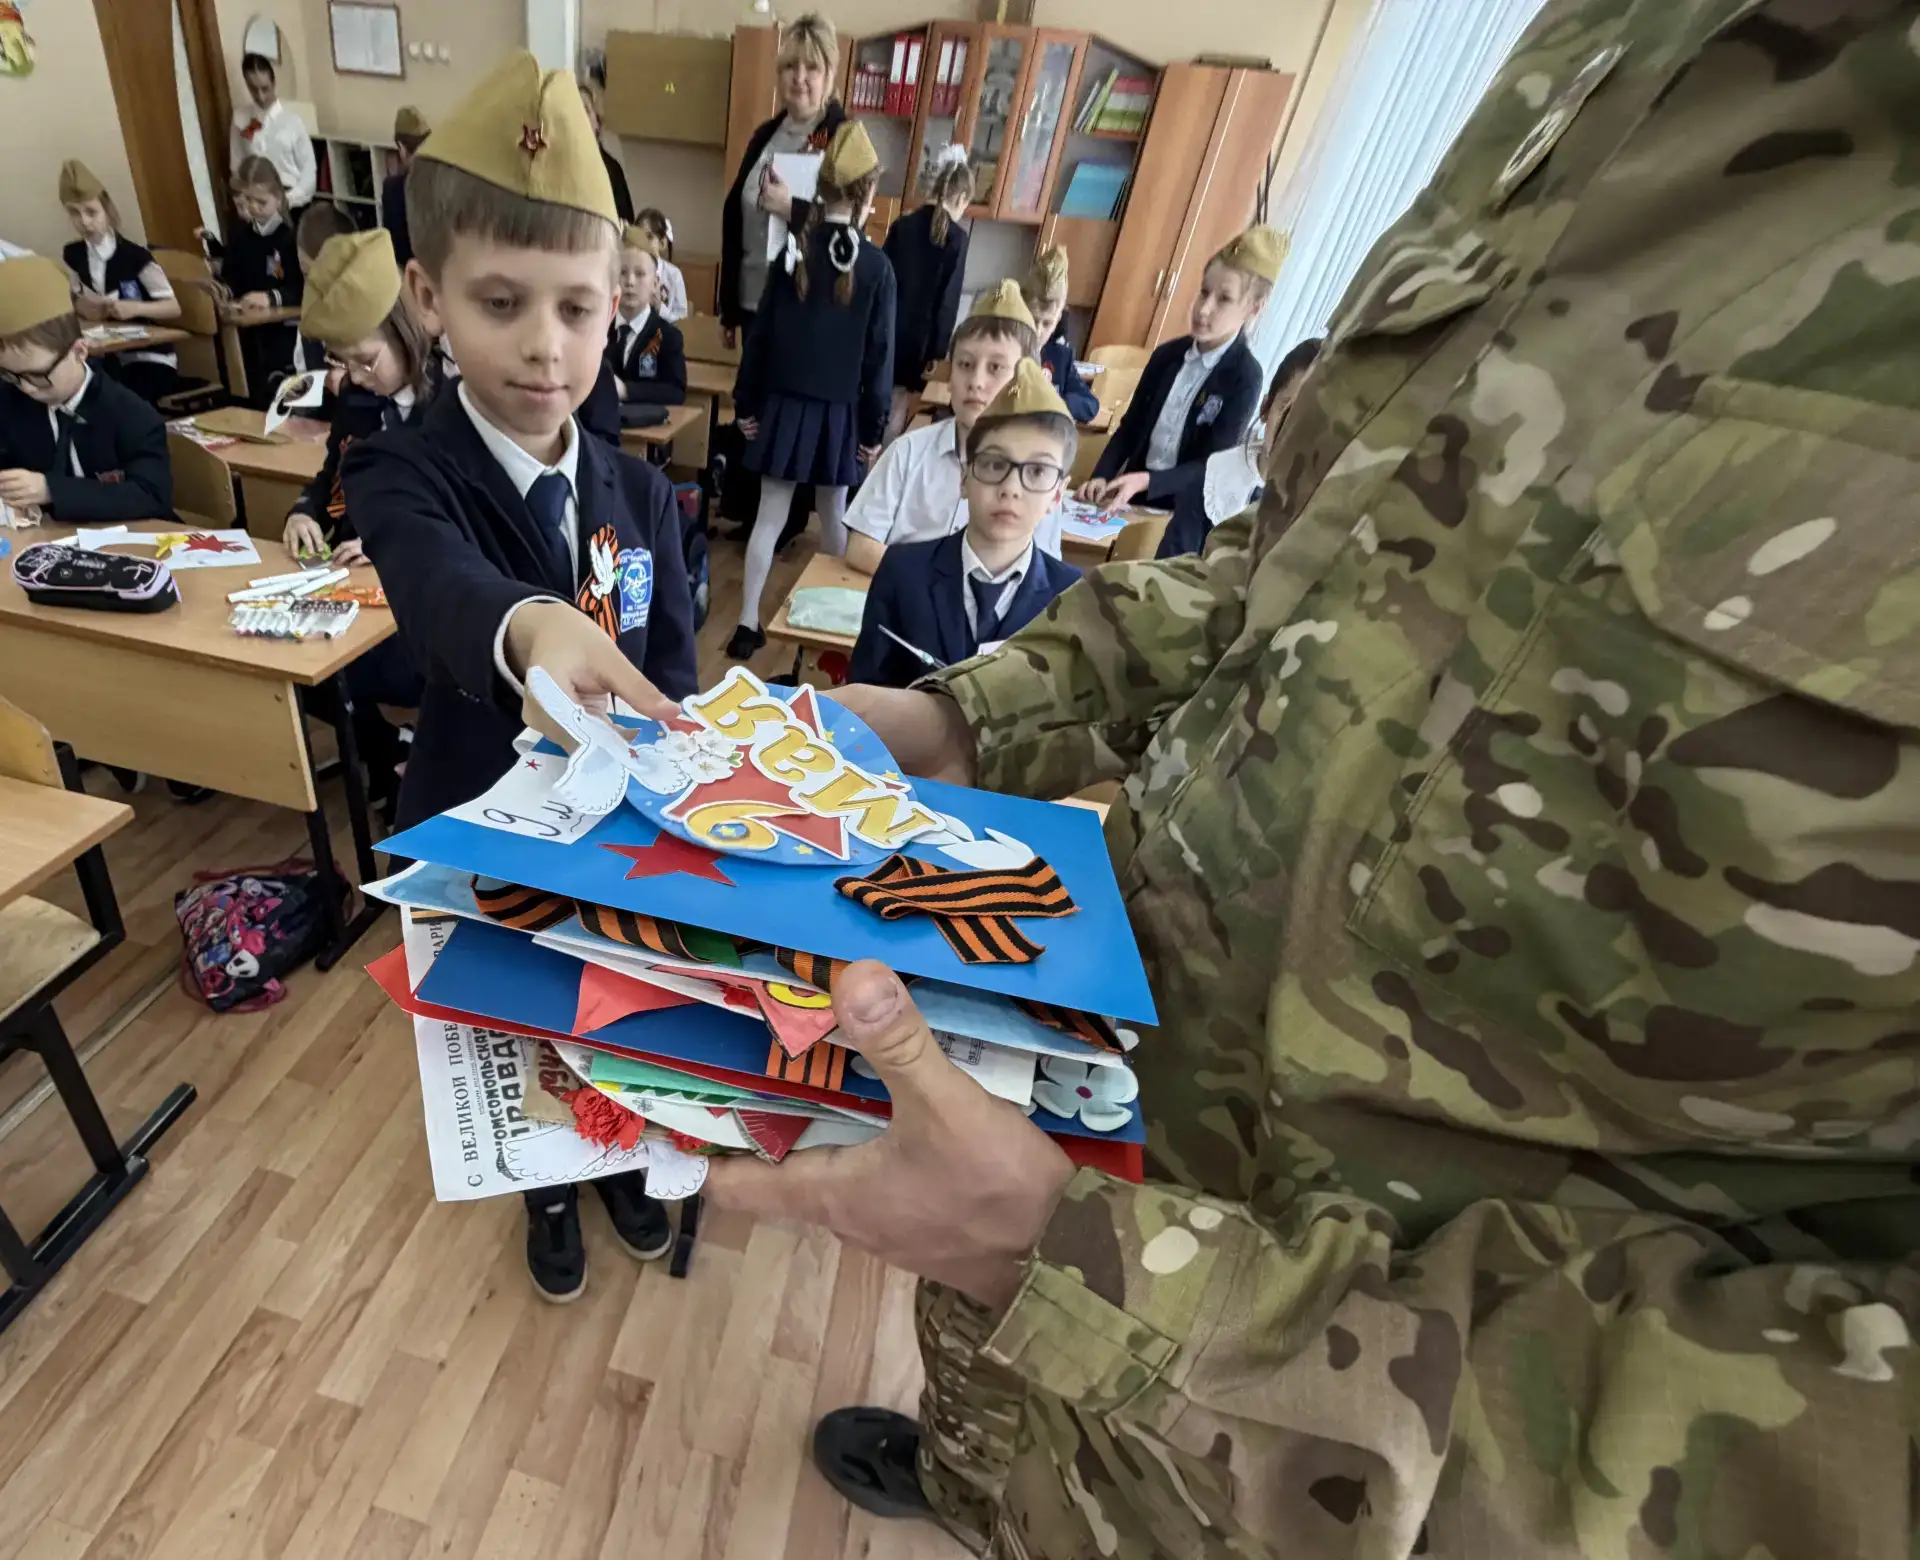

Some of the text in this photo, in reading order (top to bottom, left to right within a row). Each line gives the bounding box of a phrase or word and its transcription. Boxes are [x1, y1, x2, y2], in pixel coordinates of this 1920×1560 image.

[686, 800, 809, 850] 9
[444, 1023, 463, 1066] ПОБЕ
[473, 1027, 508, 1150] ОМСОМОЛЬСКАЯ
[452, 1075, 479, 1163] ВЕЛИКОЙ
[467, 1173, 484, 1187] С
